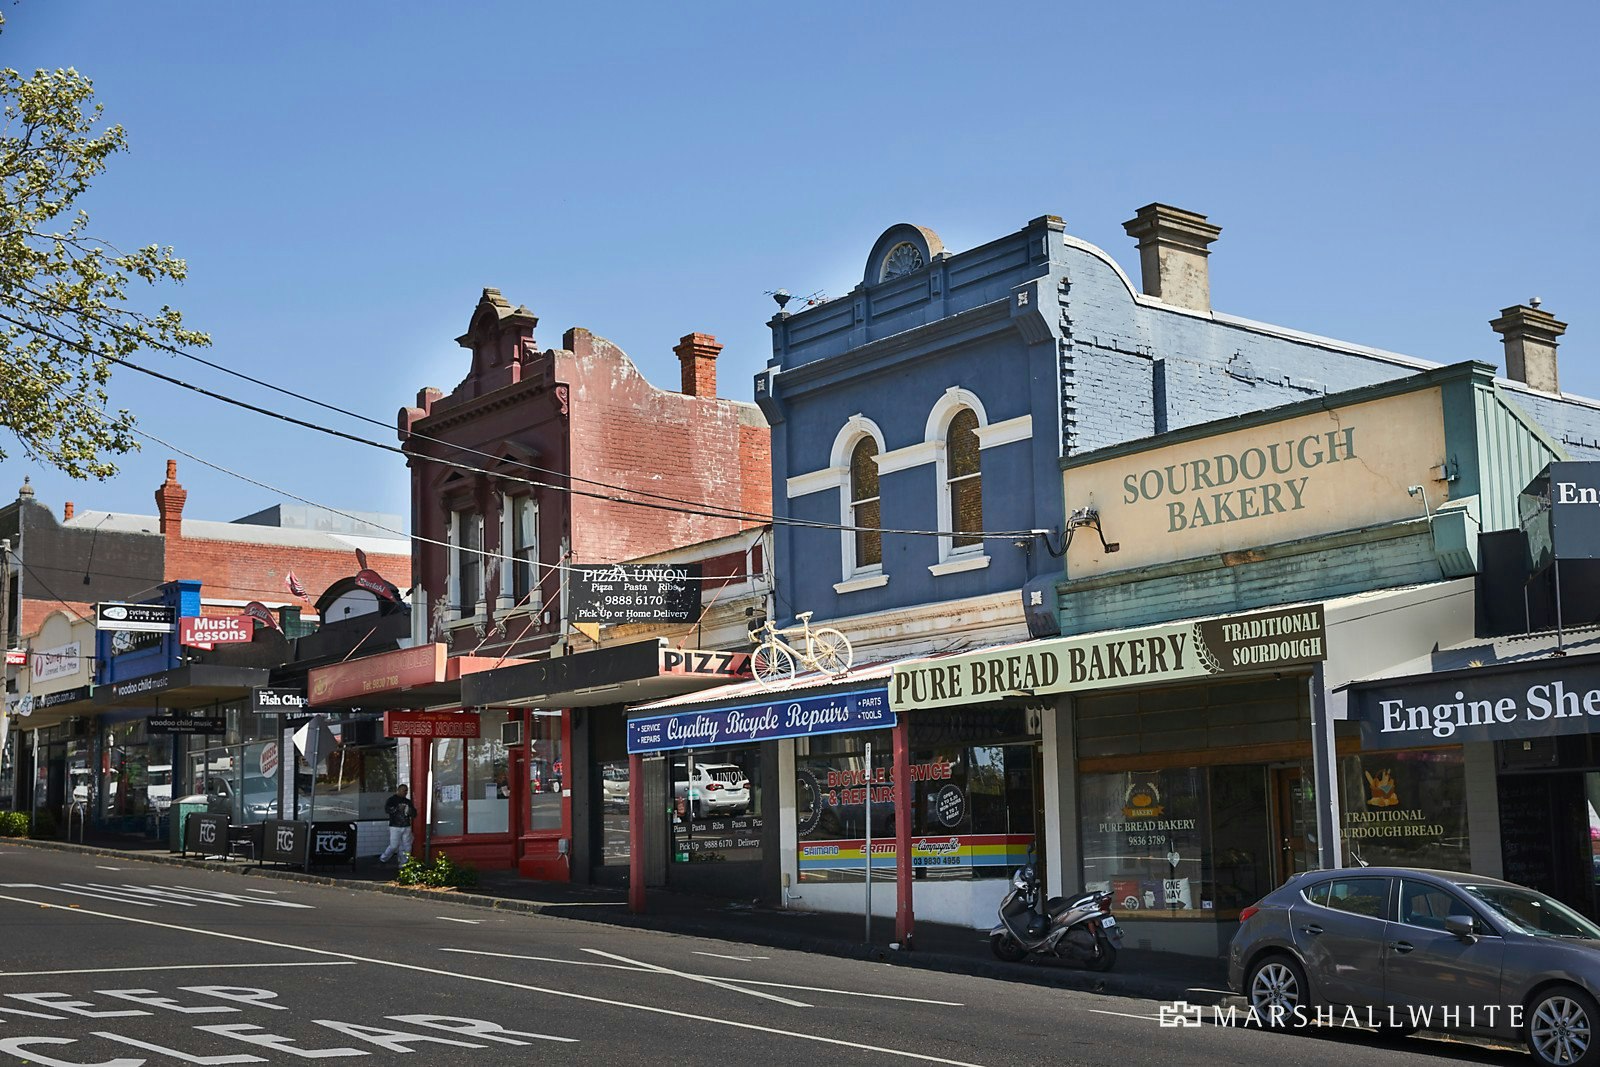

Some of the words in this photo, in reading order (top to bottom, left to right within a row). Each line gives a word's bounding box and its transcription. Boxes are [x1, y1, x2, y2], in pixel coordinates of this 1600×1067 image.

[1123, 426, 1356, 505] SOURDOUGH
[1556, 482, 1600, 507] En
[1166, 477, 1309, 532] BAKERY
[582, 569, 629, 582] PIZZA
[635, 569, 688, 581] UNION
[592, 583, 613, 592] Pizza
[624, 583, 648, 591] Pasta
[659, 582, 678, 591] Ribs
[605, 596, 632, 605] 9888
[635, 595, 663, 605] 6170
[579, 610, 598, 618] Pick
[600, 610, 612, 619] Up
[626, 610, 651, 618] Home
[653, 610, 689, 619] Delivery
[194, 618, 239, 630] Music
[1222, 611, 1320, 643] TRADITIONAL
[186, 629, 247, 642] Lessons
[1232, 636, 1322, 667] SOURDOUGH
[7, 656, 25, 664] POST
[664, 651, 752, 676] PIZZA
[894, 664, 962, 704] PURE
[970, 651, 1058, 696] BREAD
[1068, 632, 1187, 683] BAKERY
[118, 683, 137, 695] voodoo
[259, 692, 281, 705] Fish
[862, 697, 881, 707] PARTS
[861, 710, 882, 719] TOOLS
[1379, 691, 1517, 737] Engine
[392, 721, 432, 735] EXPRESS
[436, 721, 476, 736] NOODLES
[641, 723, 660, 733] SERVICE
[667, 715, 719, 742] Quality
[725, 707, 779, 739] Bicycle
[786, 702, 849, 731] Repairs
[641, 735, 660, 743] REPAIRS
[829, 790, 838, 806] &
[1344, 810, 1425, 823] TRADITIONAL
[712, 822, 724, 830] Ribs
[1099, 822, 1123, 832] PURE
[1125, 820, 1156, 831] BREAD
[1158, 819, 1196, 830] BAKERY
[1339, 826, 1401, 838] URDOUGH
[1404, 825, 1444, 836] BREAD
[680, 842, 690, 850] Pick
[692, 842, 699, 851] Up
[719, 839, 732, 847] 6170
[738, 838, 760, 847] Delivery
[914, 838, 961, 855] Campagnolo
[1129, 836, 1146, 846] 9836
[1147, 835, 1165, 845] 3789
[804, 845, 839, 856] SHIMANO
[914, 857, 922, 865] 03
[924, 857, 941, 865] 9830
[1165, 880, 1180, 890] ONE
[1165, 889, 1181, 899] WAY
[0, 1013, 580, 1067] CLEAR
